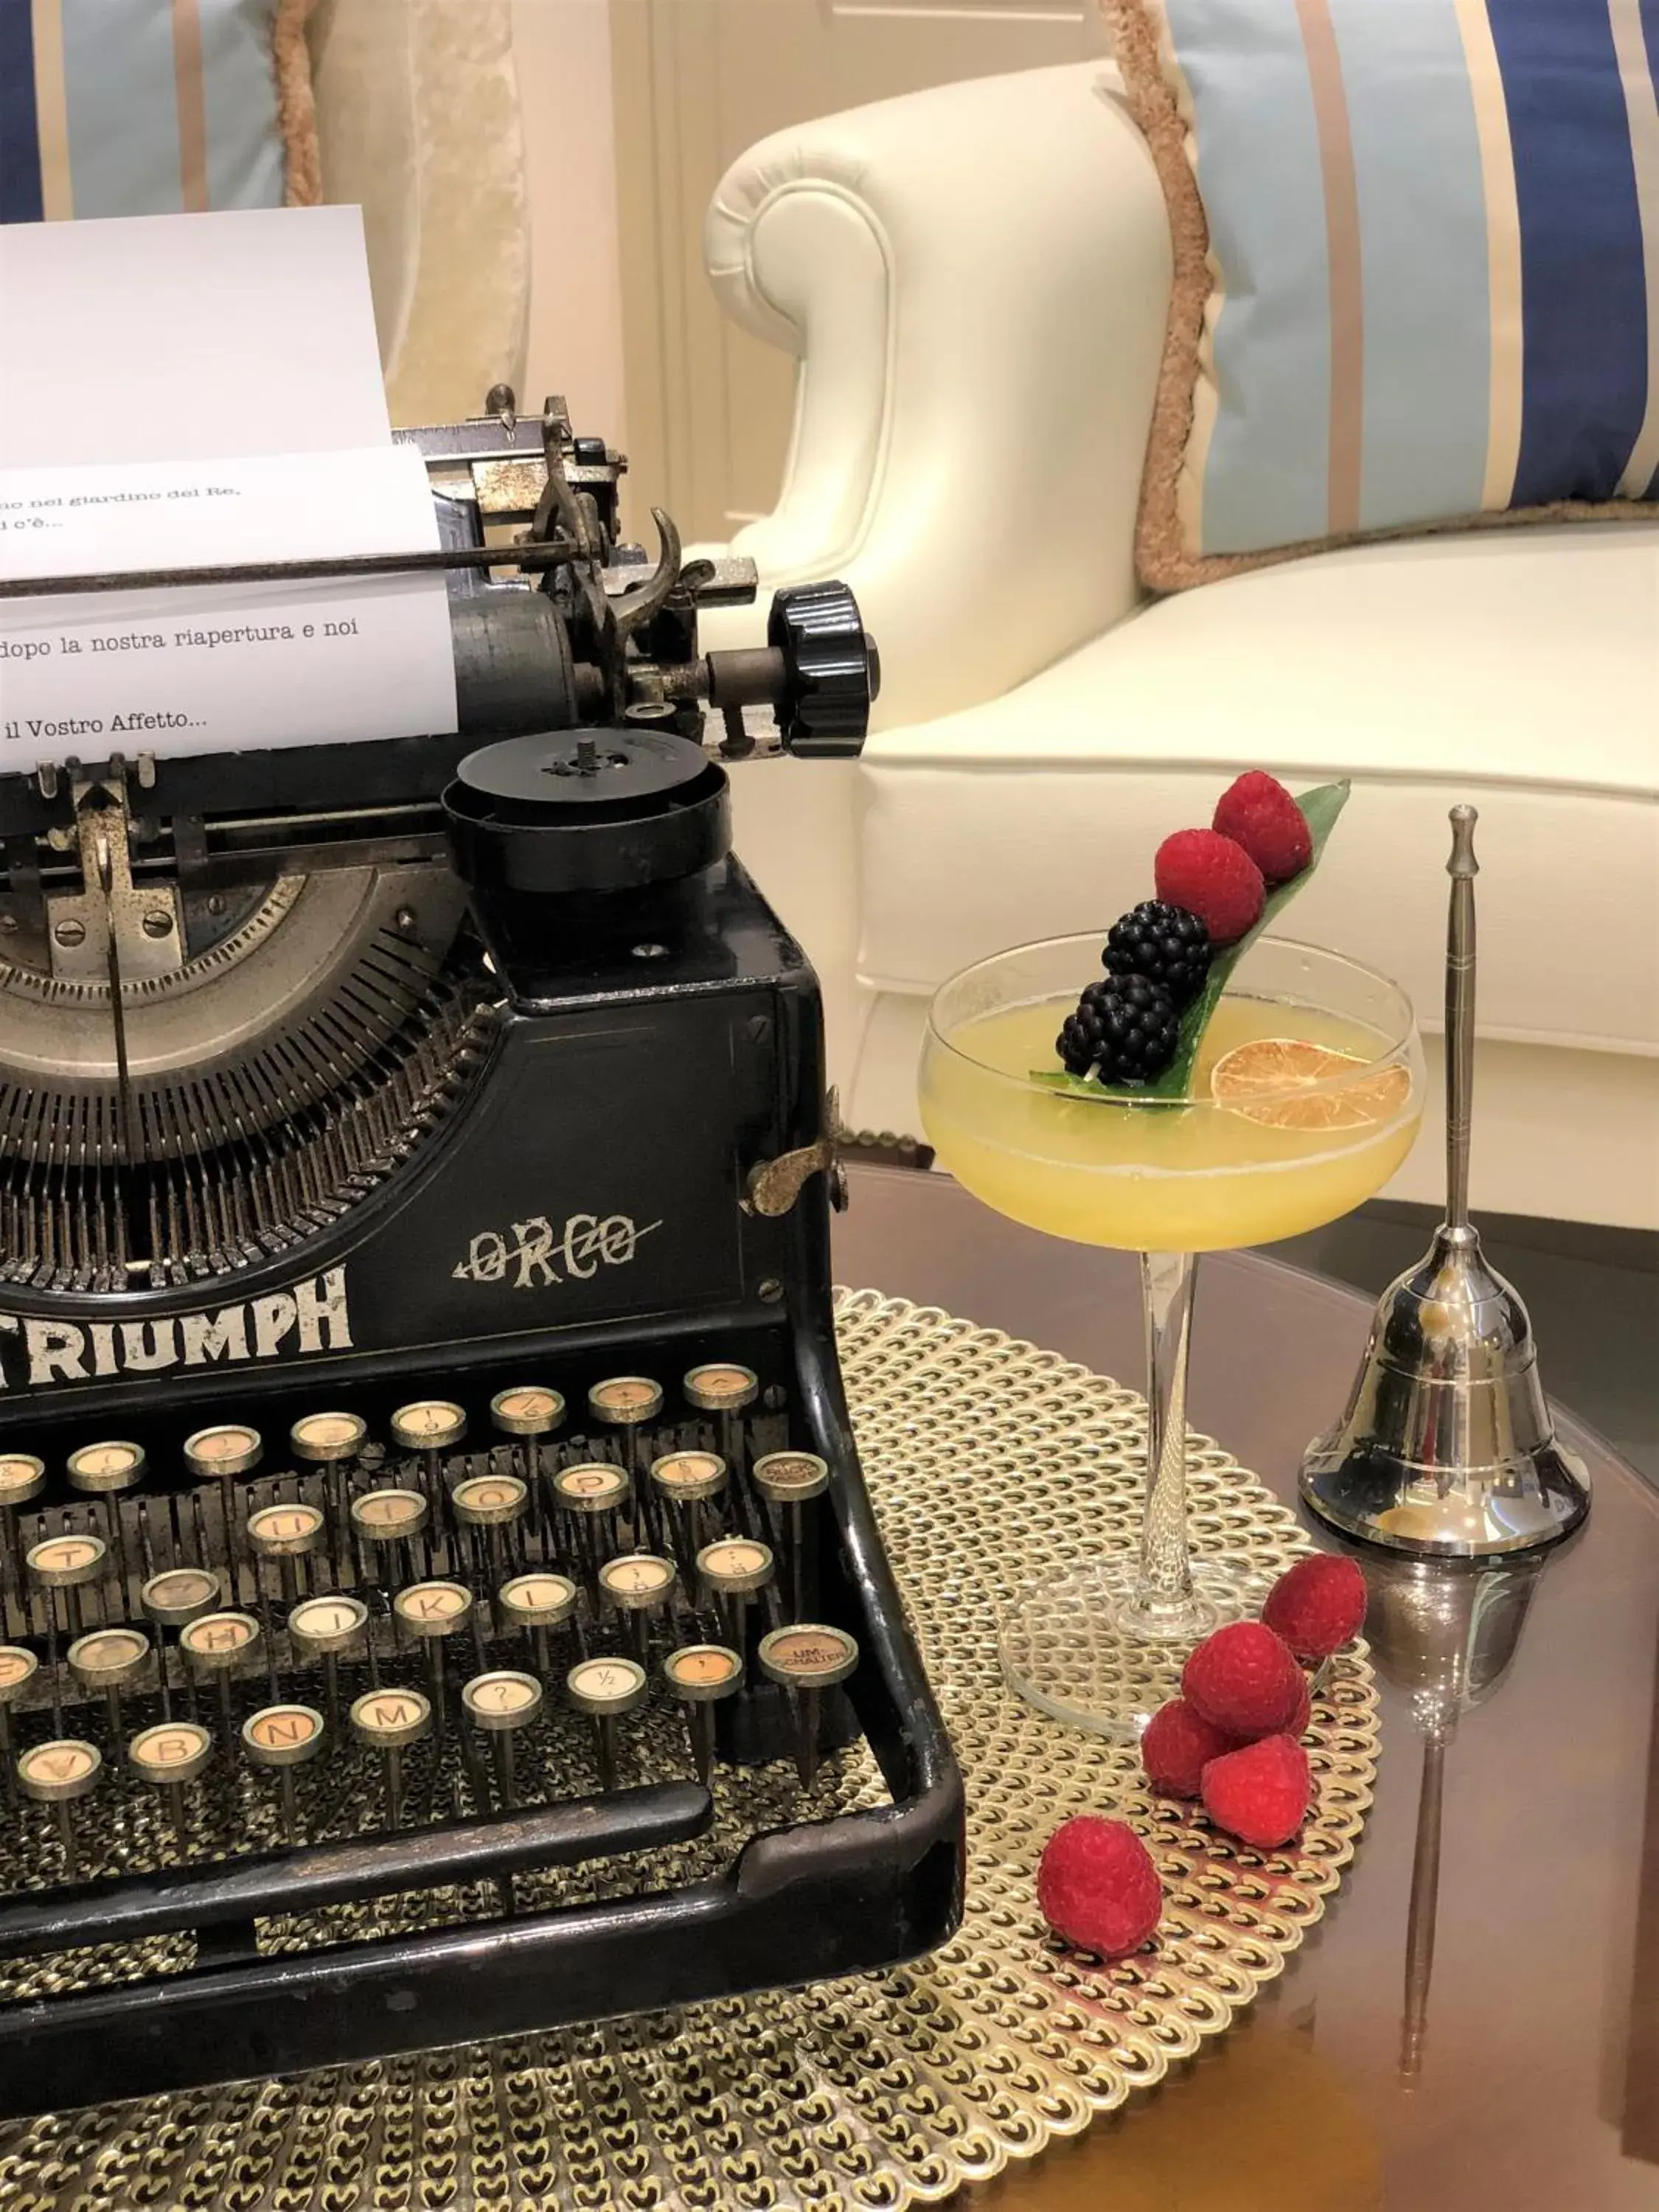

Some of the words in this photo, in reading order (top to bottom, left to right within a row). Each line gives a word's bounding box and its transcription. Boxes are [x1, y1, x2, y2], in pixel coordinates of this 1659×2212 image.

[29, 498, 63, 509] nel
[69, 492, 161, 507] giardino
[167, 489, 199, 500] del
[0, 641, 52, 661] dopo
[60, 637, 83, 654] la
[91, 633, 167, 653] nostra
[174, 625, 295, 648] riapertura
[303, 624, 315, 638] e
[323, 618, 359, 637] noi
[5, 722, 21, 739] il
[26, 718, 104, 737] Vostro
[111, 712, 207, 732] Affetto...
[420, 1596, 451, 1618] K
[375, 1705, 408, 1726] M
[268, 1720, 299, 1745] N
[158, 1739, 189, 1761] B
